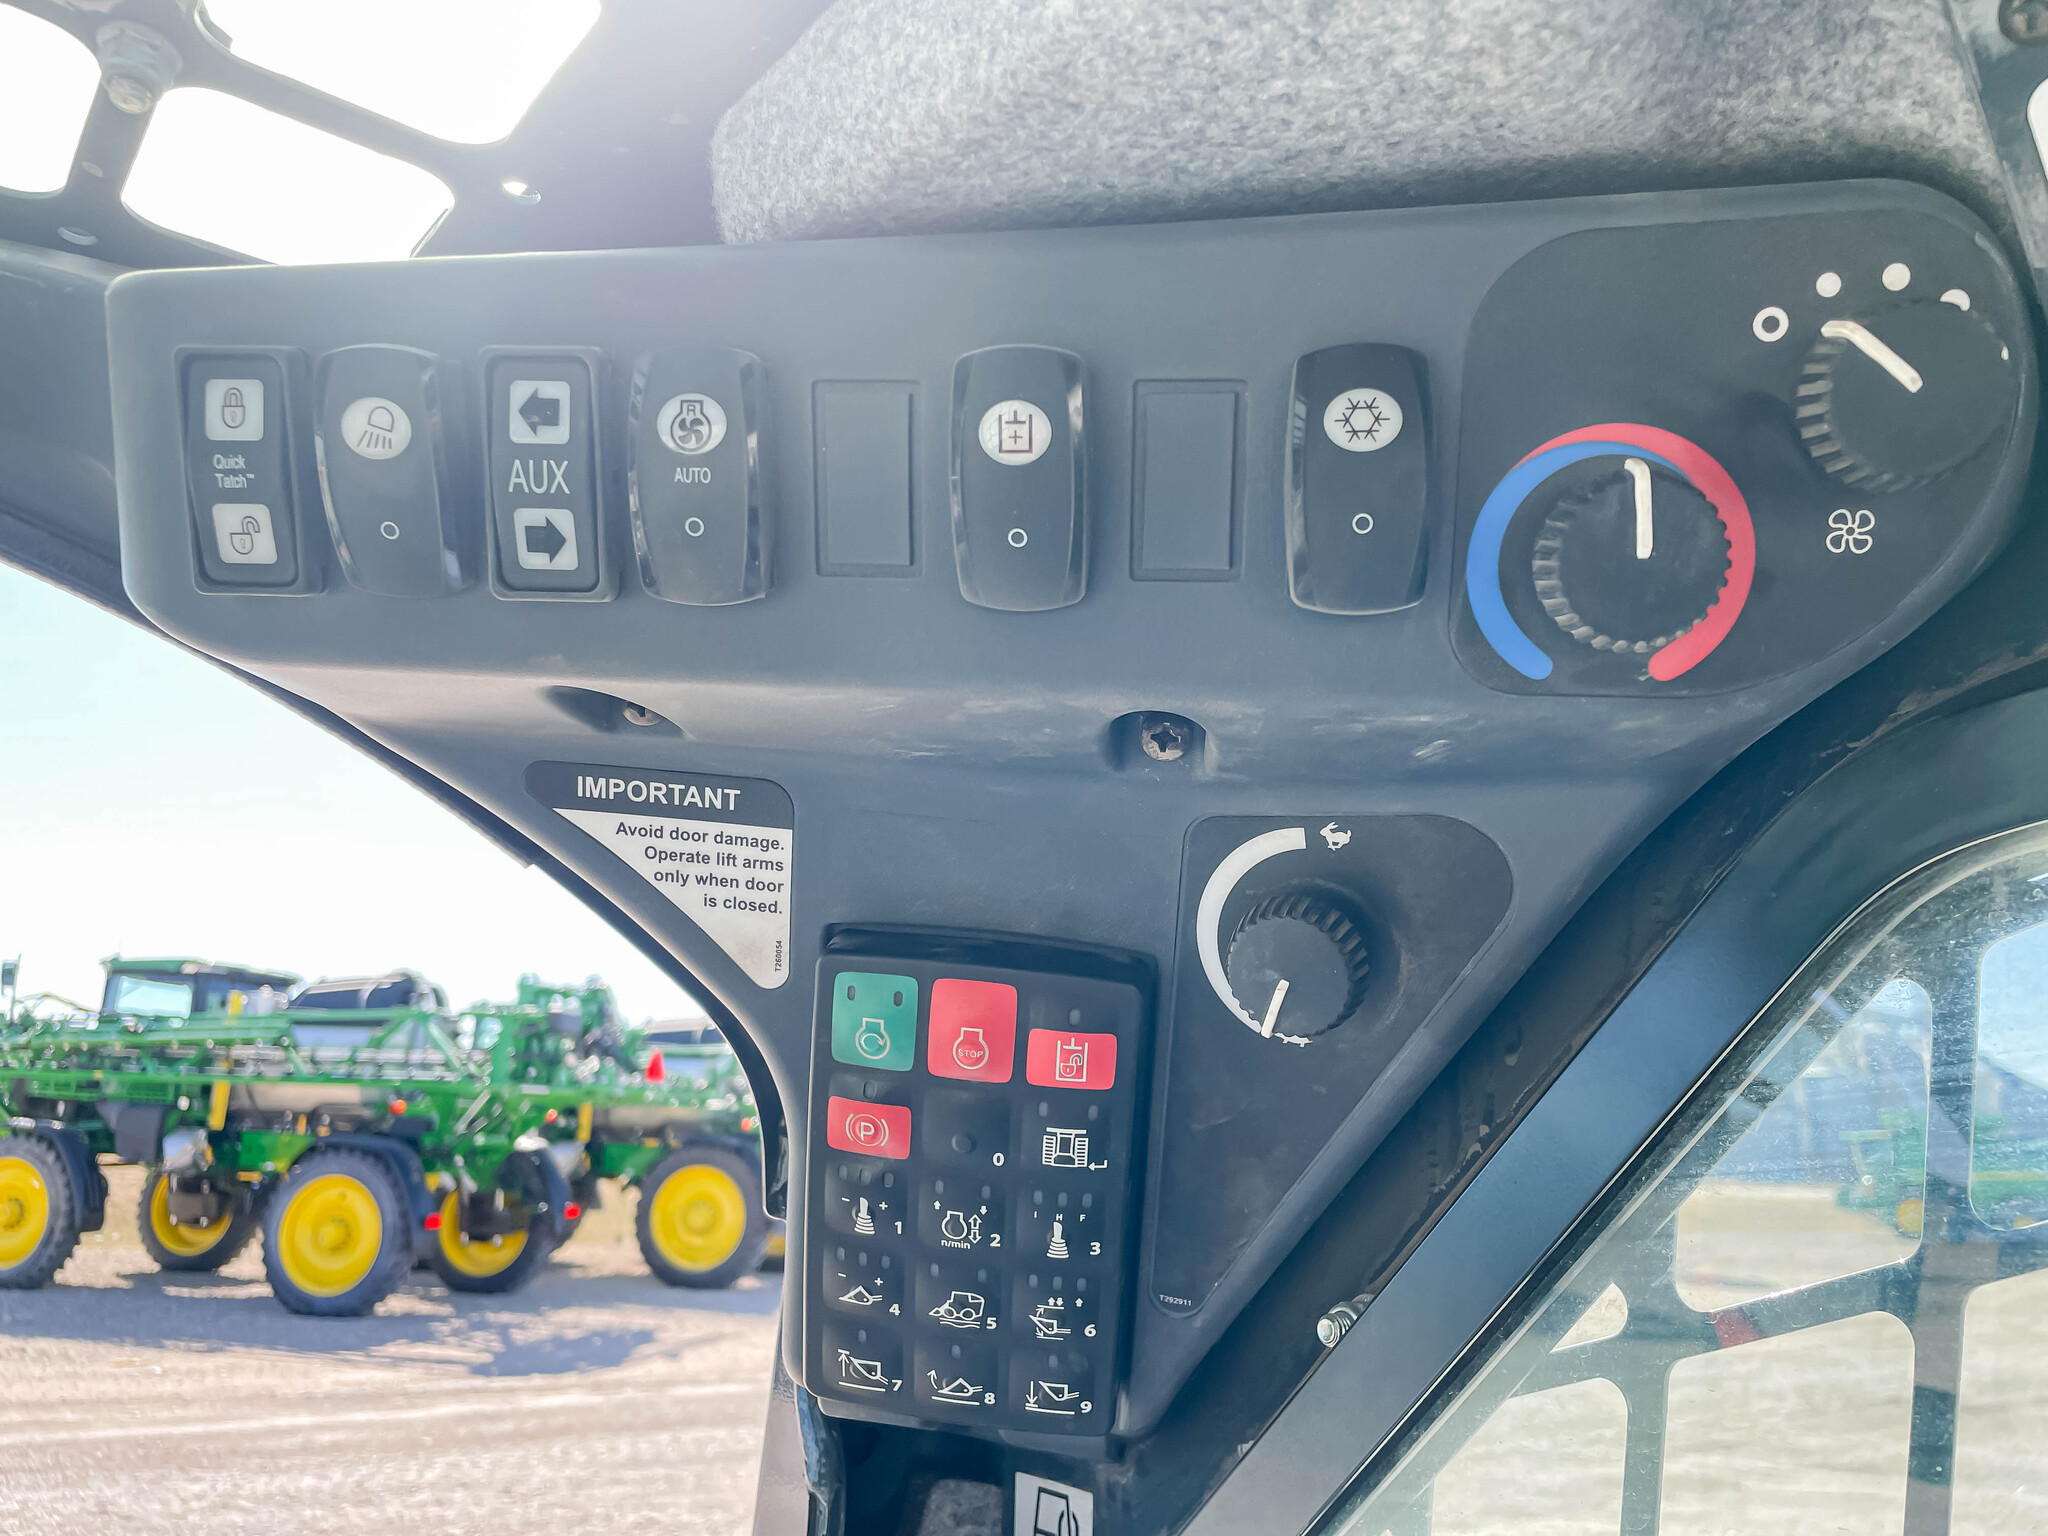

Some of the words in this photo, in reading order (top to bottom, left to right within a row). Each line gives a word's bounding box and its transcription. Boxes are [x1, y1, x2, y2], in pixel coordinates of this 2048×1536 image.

[213, 454, 246, 469] Quick
[508, 459, 571, 495] AUX
[674, 467, 712, 484] AUTO
[577, 775, 741, 811] IMPORTANT
[616, 822, 664, 840] Avoid
[669, 827, 709, 843] door
[714, 831, 785, 852] damage.
[644, 846, 711, 866] Operate
[716, 852, 738, 867] lift
[742, 858, 784, 872] arms
[654, 870, 690, 887] only
[695, 873, 740, 888] when
[745, 878, 785, 893] door
[703, 894, 717, 907] is
[723, 896, 783, 914] closed.
[774, 940, 783, 972] T260054
[957, 1048, 984, 1059] STOP
[860, 1122, 875, 1142] P
[1056, 1214, 1063, 1222] H
[1080, 1214, 1086, 1222] F
[894, 1221, 903, 1235] 1
[940, 1238, 972, 1250] n/min
[990, 1234, 1001, 1248] 2
[1090, 1242, 1101, 1256] 3
[1159, 1294, 1192, 1306] T292911
[889, 1303, 900, 1316] 4
[986, 1317, 997, 1330] 5
[1084, 1324, 1097, 1337] 6
[892, 1380, 903, 1392] 7
[984, 1392, 996, 1405] 8
[1080, 1400, 1092, 1414] 9
